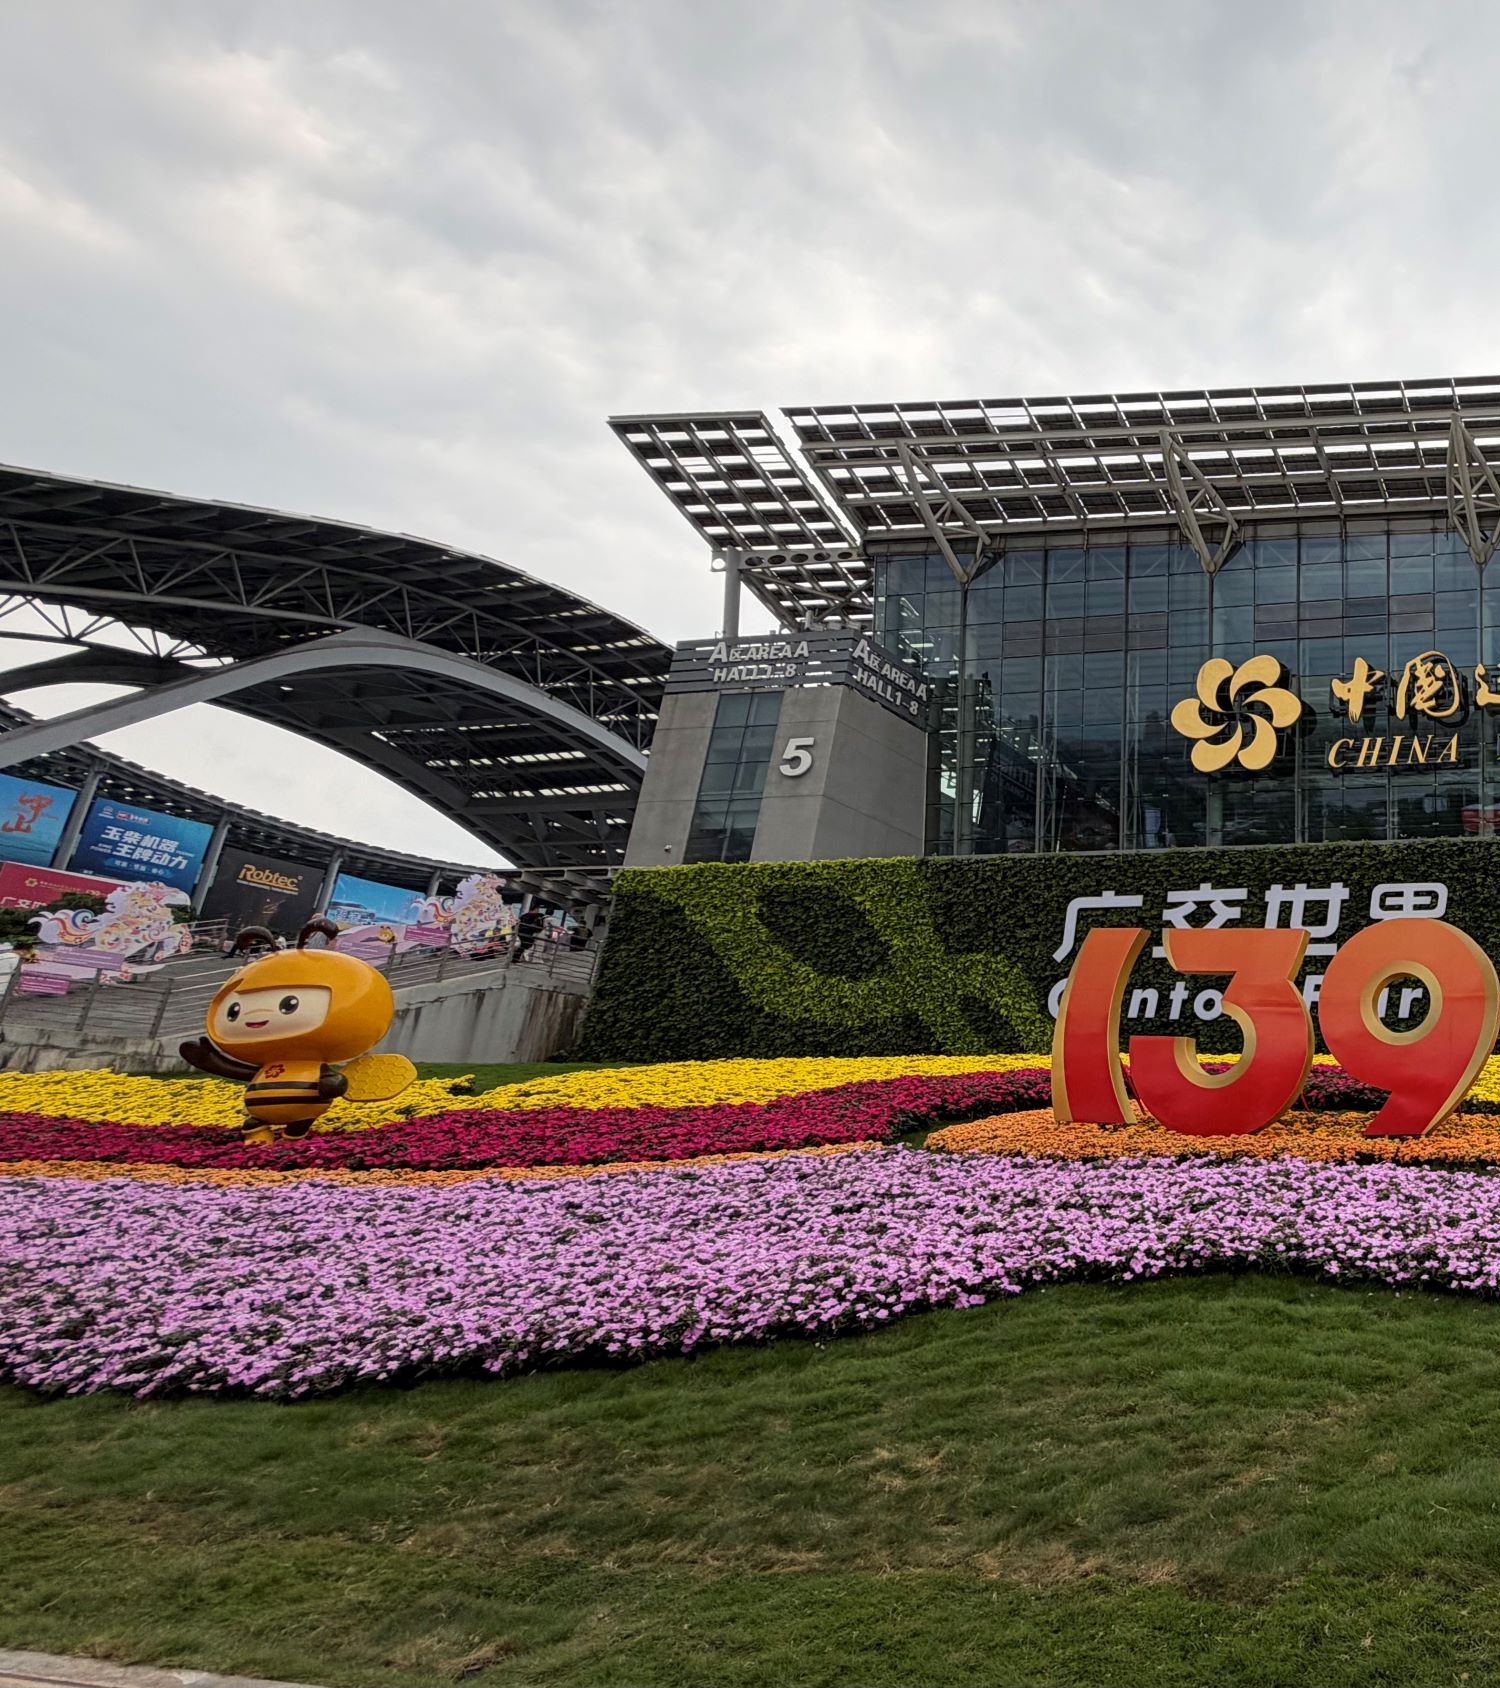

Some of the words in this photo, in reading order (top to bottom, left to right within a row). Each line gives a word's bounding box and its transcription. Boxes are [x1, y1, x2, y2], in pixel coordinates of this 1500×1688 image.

[745, 644, 792, 661] AREA
[794, 641, 809, 658] A
[713, 665, 760, 682] HALL
[880, 663, 916, 695] AREA
[916, 682, 927, 702] A
[857, 667, 894, 703] HALL
[895, 691, 919, 716] 1-8
[778, 737, 815, 777] 5
[1328, 732, 1460, 769] CHINA
[112, 842, 188, 870] 王牌动力
[238, 863, 298, 888] Robtec
